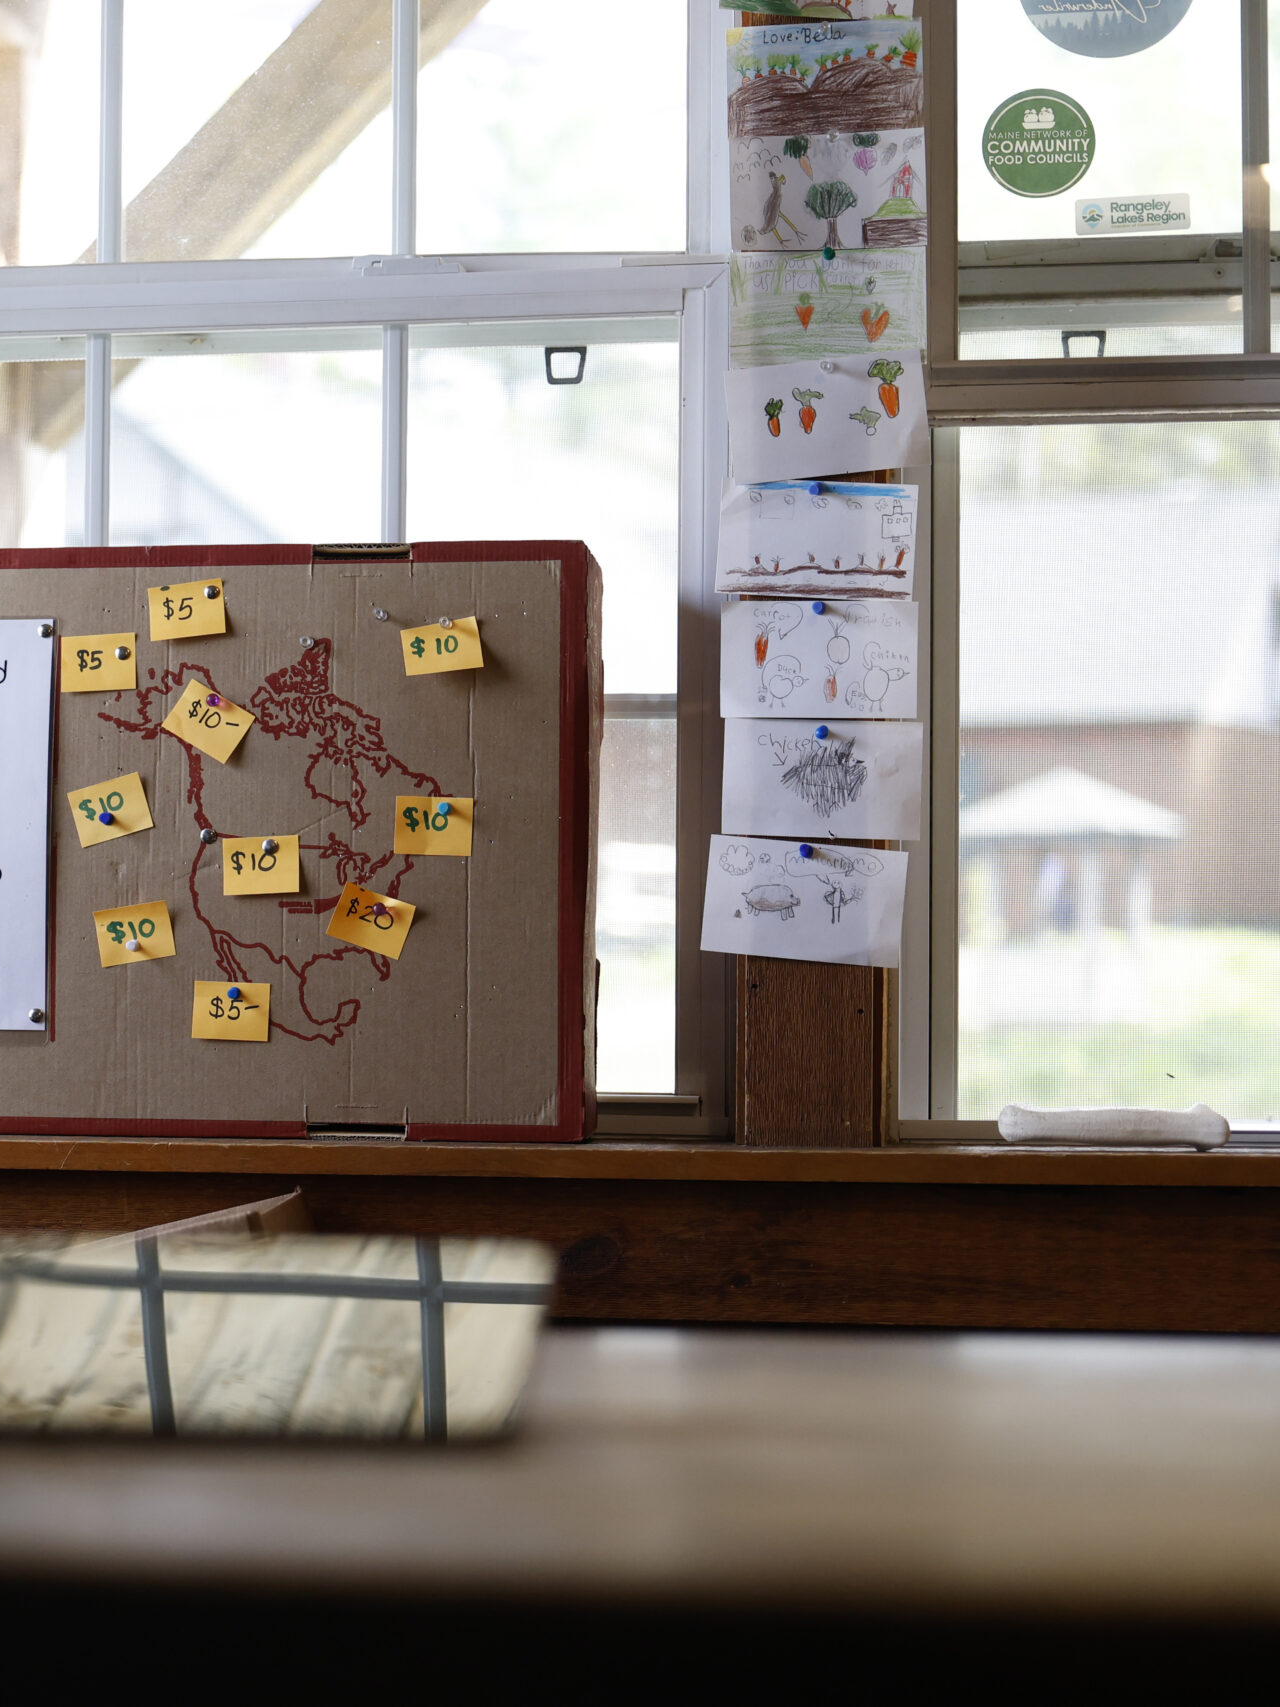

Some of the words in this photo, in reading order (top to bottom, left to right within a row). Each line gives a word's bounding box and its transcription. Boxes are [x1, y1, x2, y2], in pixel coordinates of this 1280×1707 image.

[987, 138, 1090, 154] COMMUNITY
[988, 131, 1020, 140] MAINE
[1023, 129, 1072, 139] NETWORK
[1075, 129, 1088, 137] OF
[988, 155, 1023, 165] FOOD
[1026, 153, 1089, 164] COUNCILS
[1110, 199, 1171, 215] Rangeley
[1110, 213, 1145, 225] Lakes
[1146, 211, 1186, 224] Region
[162, 597, 194, 620] $5
[76, 649, 103, 672] $5
[78, 791, 124, 821] $10
[402, 806, 449, 832] $10
[230, 850, 277, 875] $10
[346, 897, 394, 930] $20
[106, 918, 155, 944] $10
